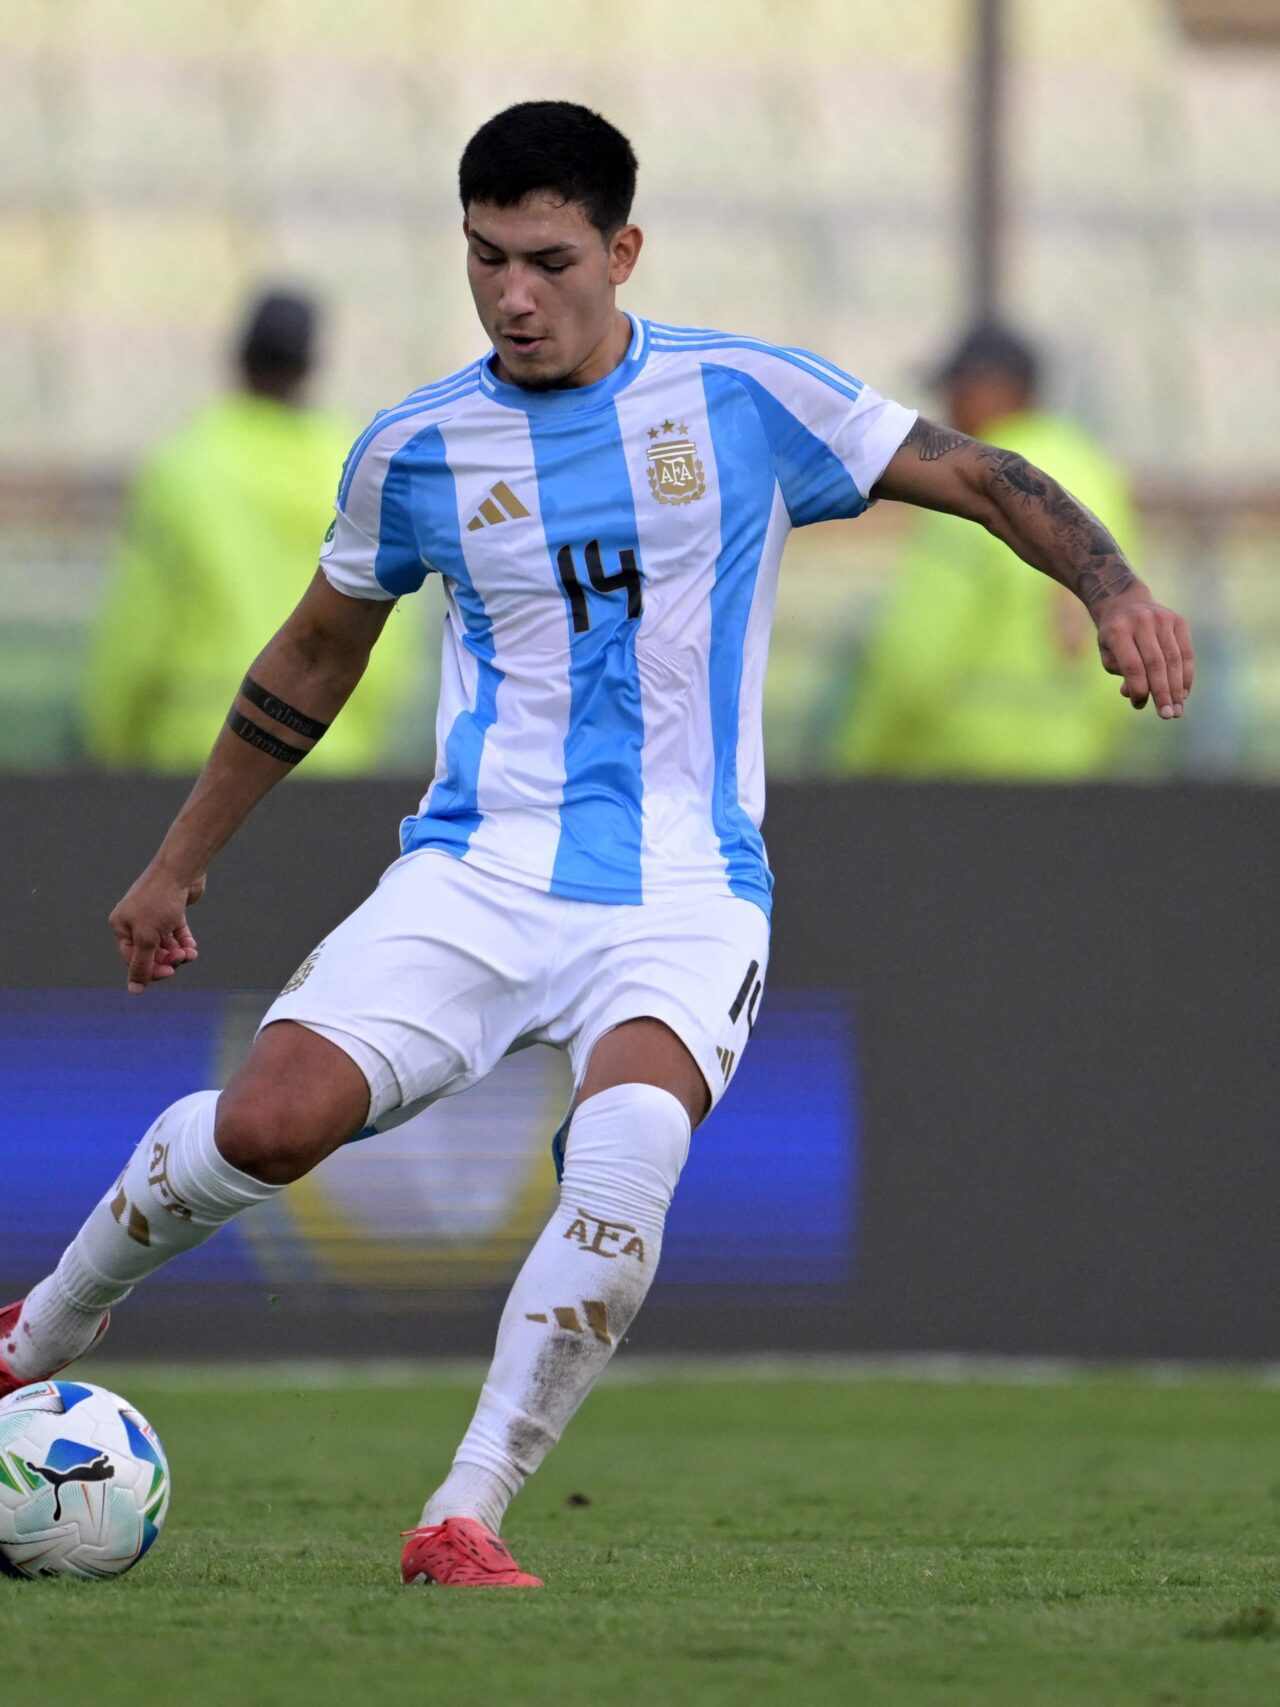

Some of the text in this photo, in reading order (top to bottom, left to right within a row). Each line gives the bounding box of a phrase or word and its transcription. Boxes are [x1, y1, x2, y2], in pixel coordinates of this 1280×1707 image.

[661, 457, 694, 487] AFA
[556, 537, 645, 634] 14
[562, 1207, 646, 1263] AFA
